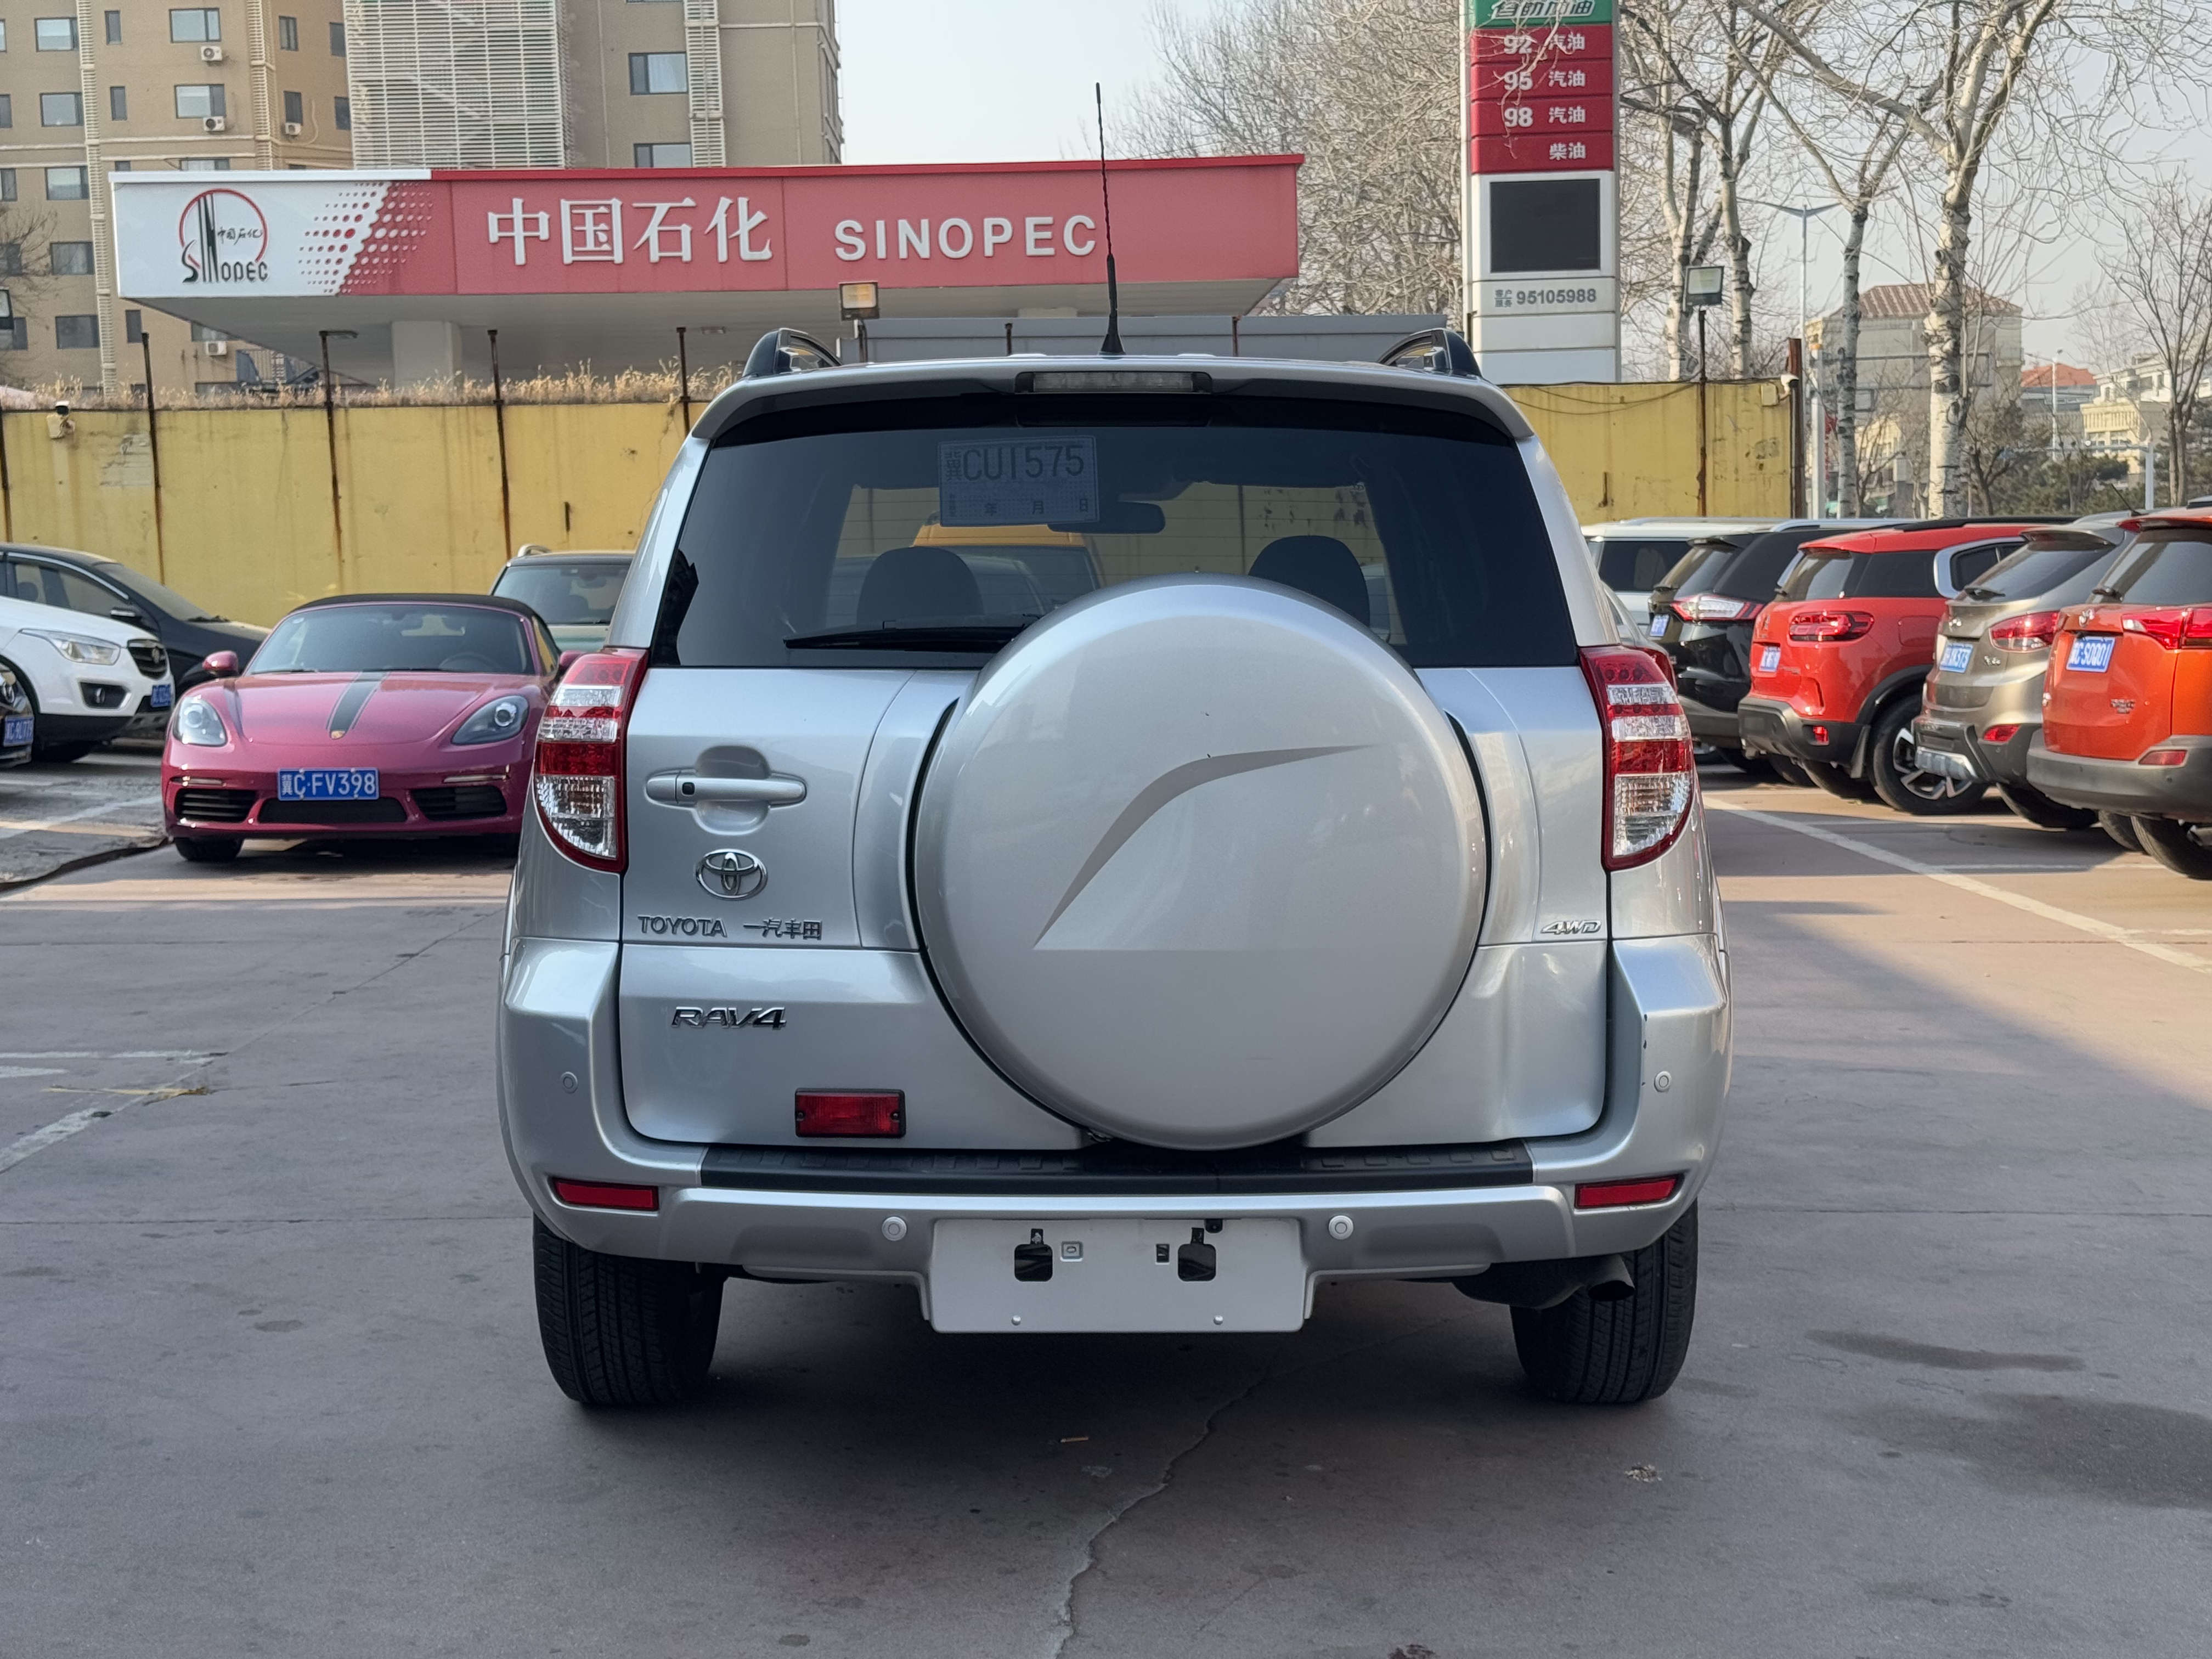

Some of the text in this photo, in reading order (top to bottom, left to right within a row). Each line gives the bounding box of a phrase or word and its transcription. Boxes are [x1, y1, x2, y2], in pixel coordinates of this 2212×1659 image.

[1503, 33, 1585, 54] 92 汽油
[1504, 70, 1585, 91] 95 汽油
[1504, 105, 1585, 127] 98 汽油
[1549, 142, 1585, 160] 柴油
[487, 196, 772, 266] 中国石化
[835, 215, 1096, 262] SINOPEC
[1516, 289, 1597, 304] 95105988
[984, 498, 1089, 516] 年 月 日
[637, 914, 823, 941] TOYOTA 一汽丰田
[1541, 919, 1602, 935] 4WD
[671, 1006, 787, 1030] RAV4
